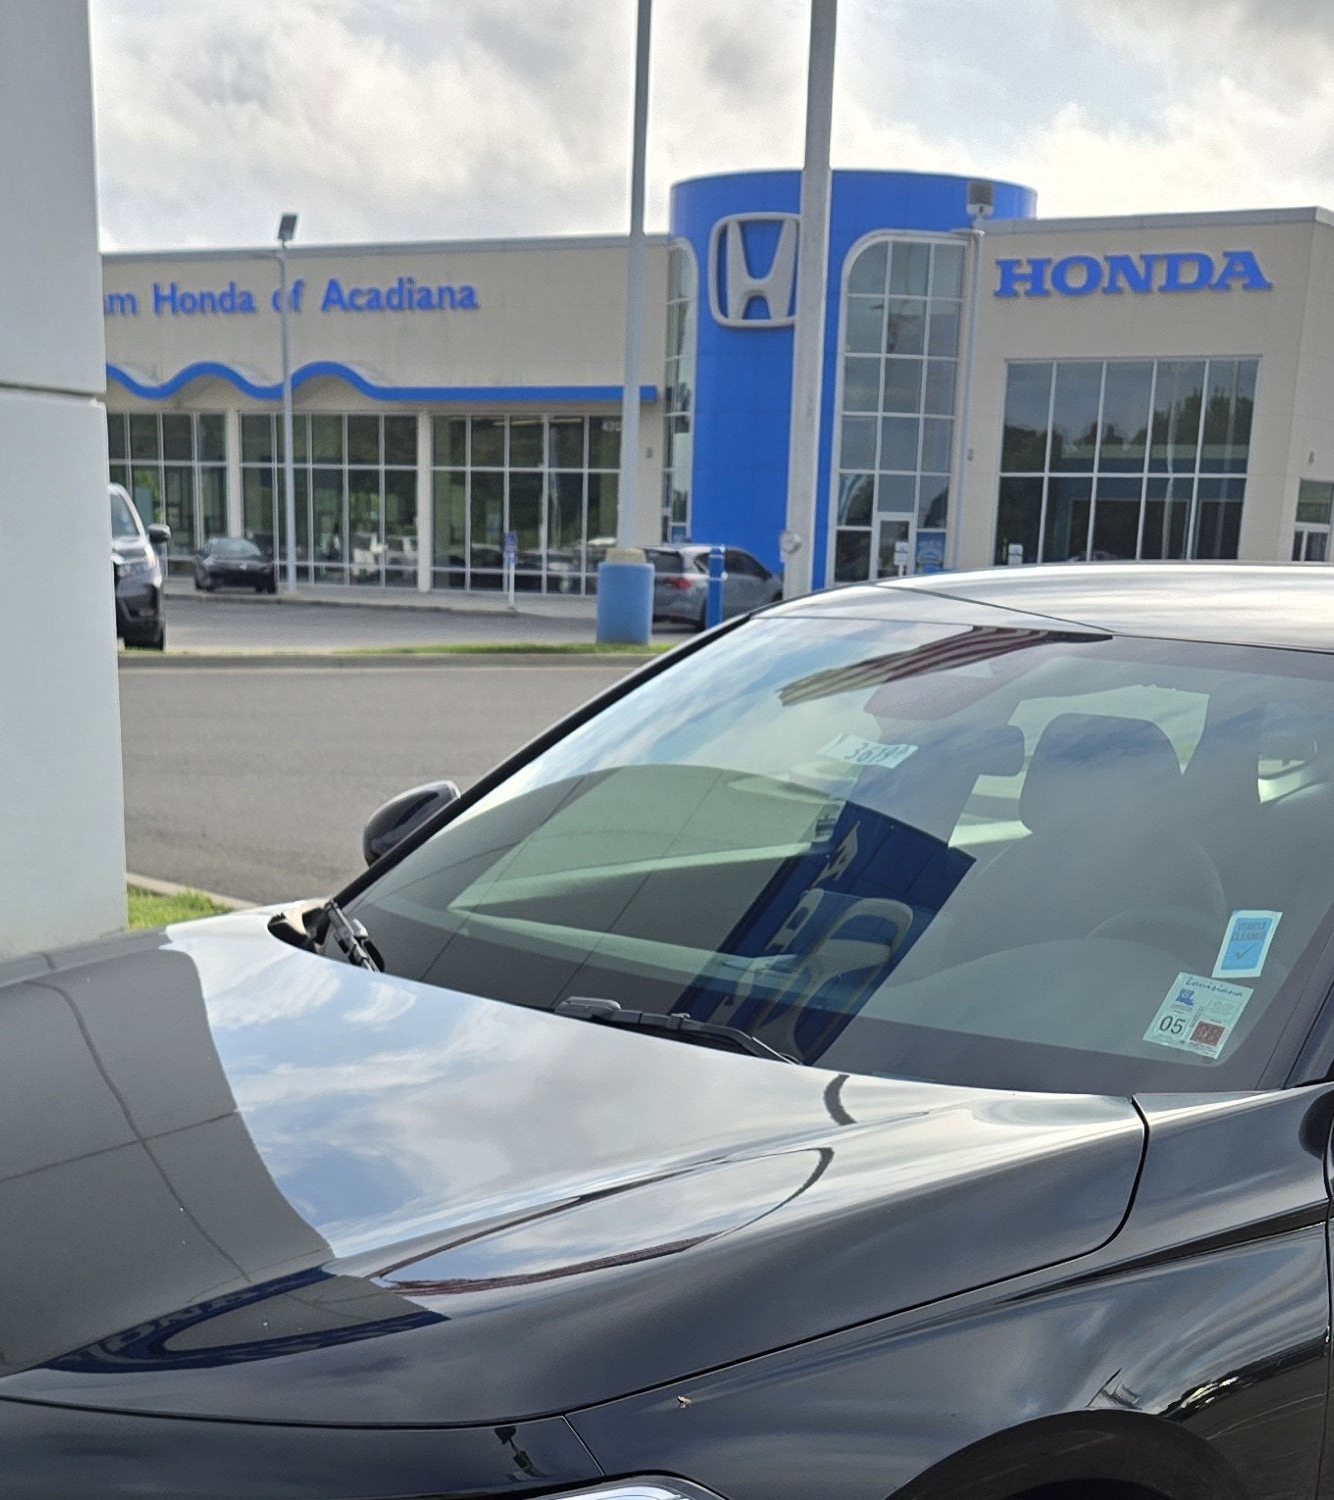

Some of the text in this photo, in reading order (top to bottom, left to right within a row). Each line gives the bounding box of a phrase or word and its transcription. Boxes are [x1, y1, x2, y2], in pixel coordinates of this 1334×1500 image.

[993, 249, 1274, 298] HONDA
[152, 280, 257, 316] Honda
[321, 276, 480, 313] Acadiana
[1185, 977, 1244, 998] Louisiana
[1159, 1015, 1187, 1035] 05
